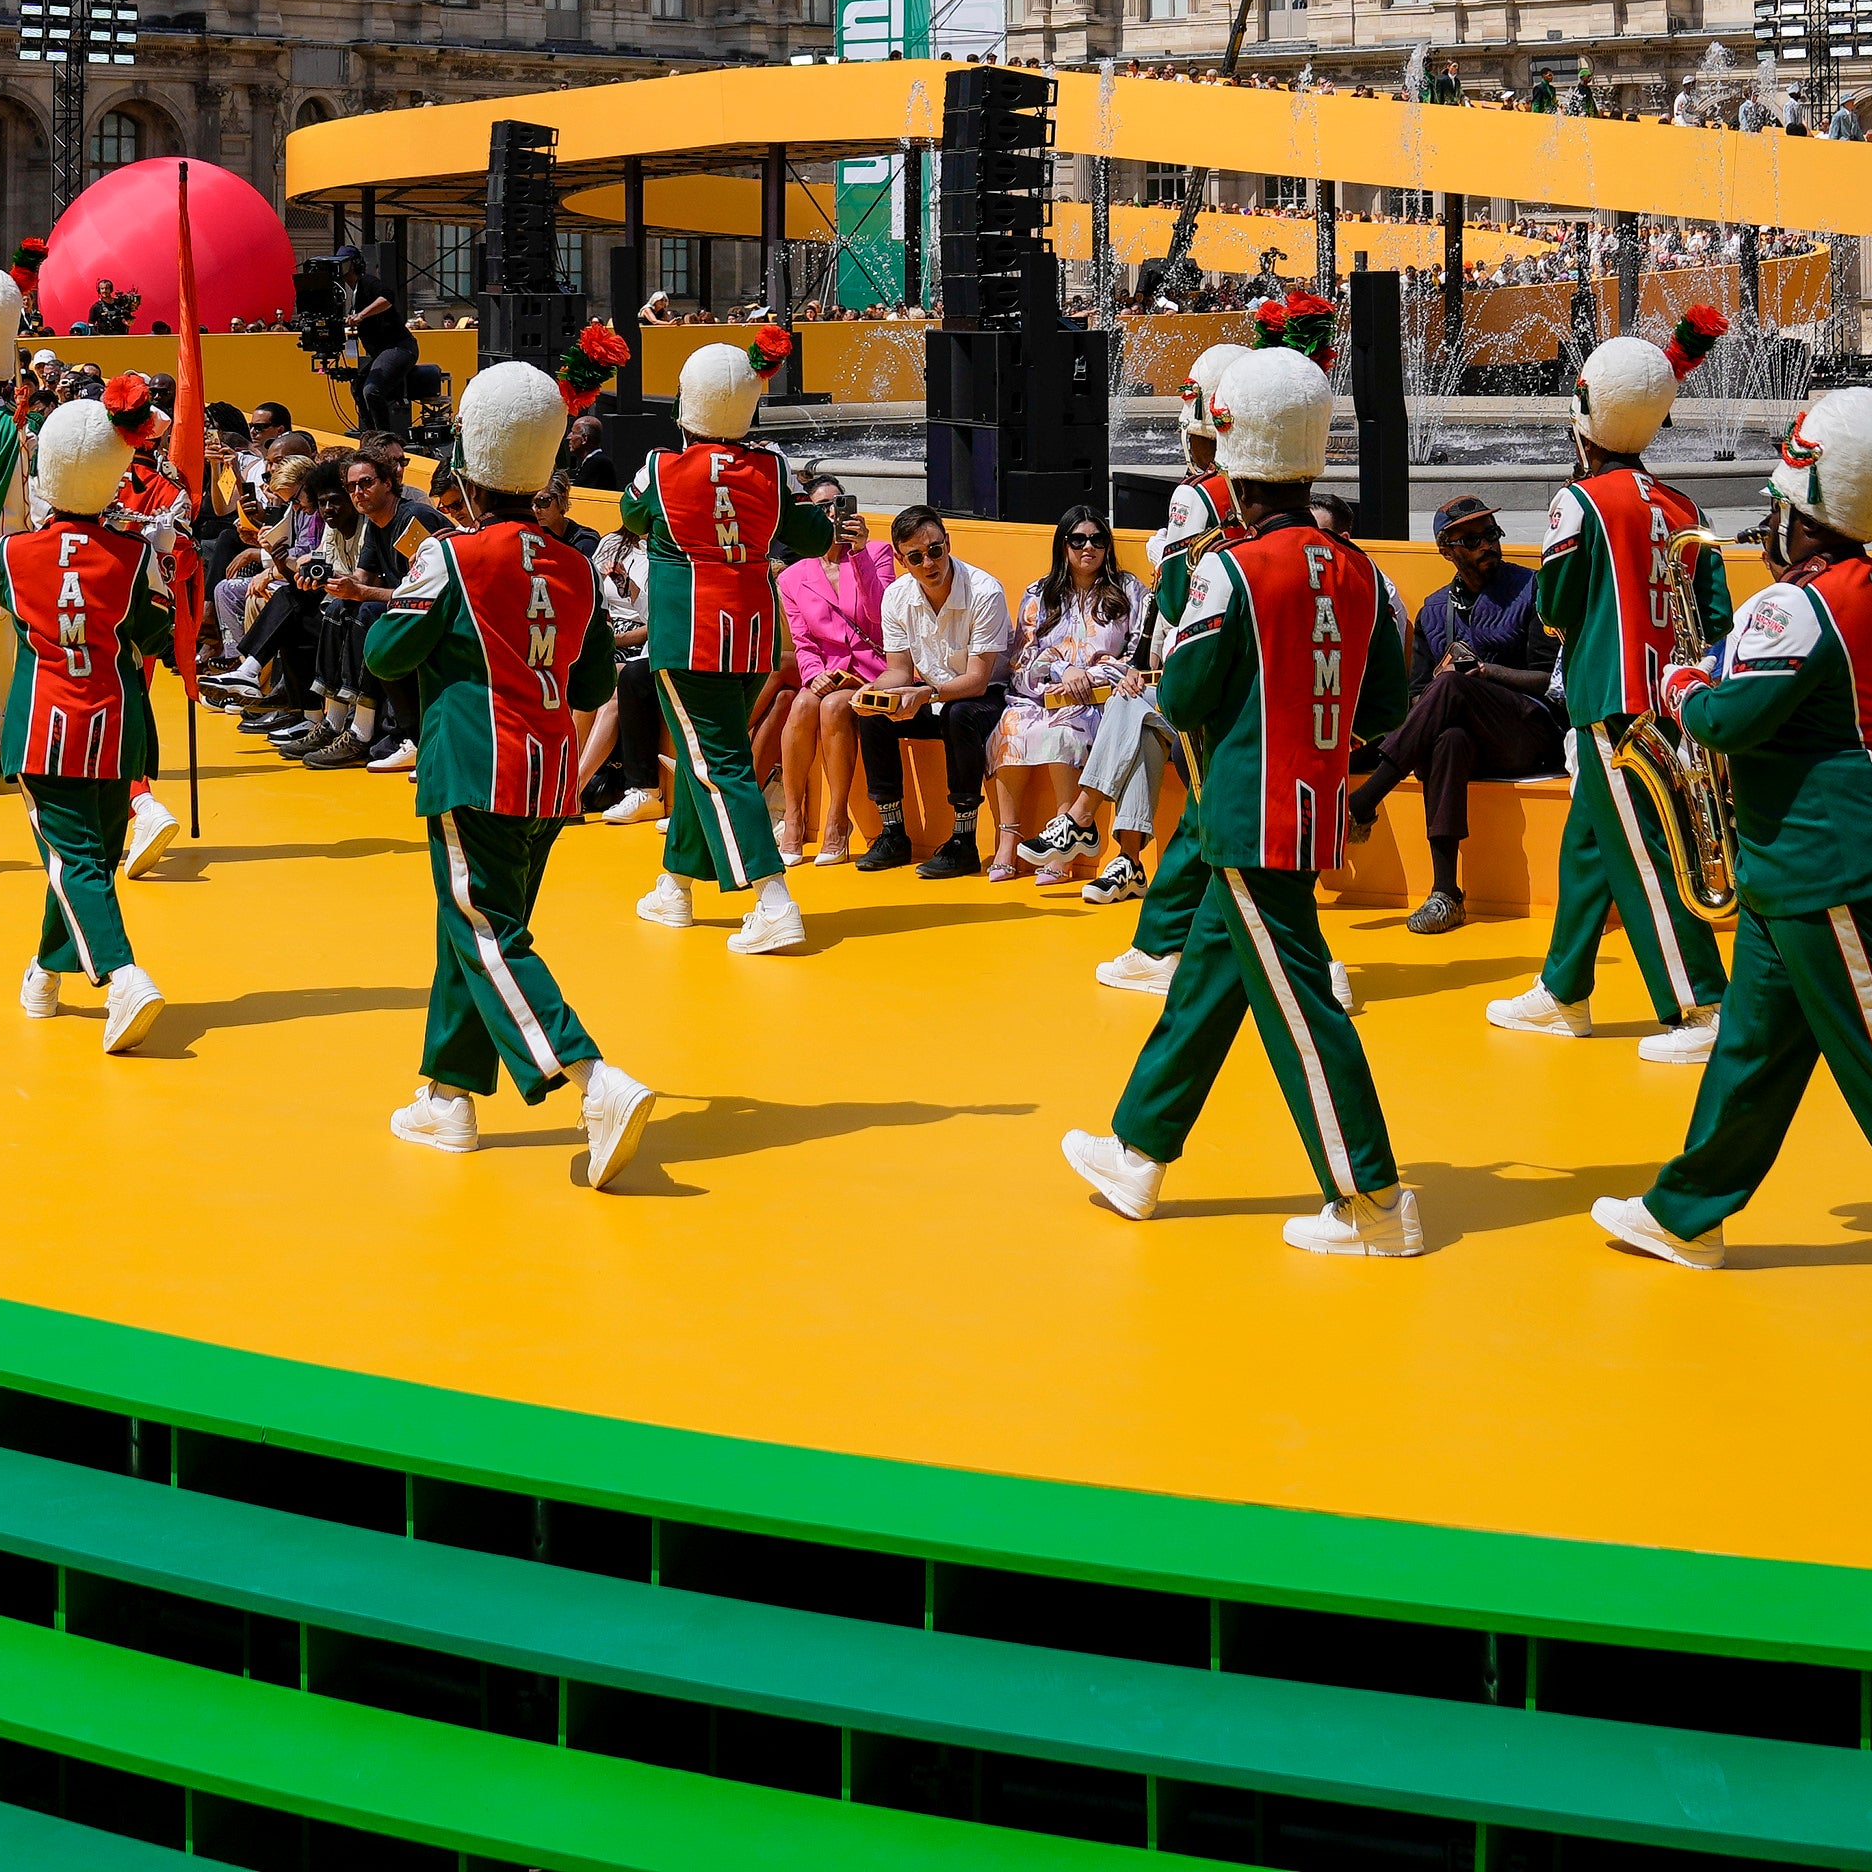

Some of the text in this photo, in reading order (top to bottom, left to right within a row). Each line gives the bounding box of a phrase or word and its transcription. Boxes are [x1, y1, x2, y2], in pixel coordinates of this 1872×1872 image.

[709, 452, 748, 564] FAMU
[1632, 471, 1671, 628] FAMU
[57, 532, 92, 678] FAMU
[518, 530, 561, 710] FAMU
[1304, 544, 1342, 750] FAMU
